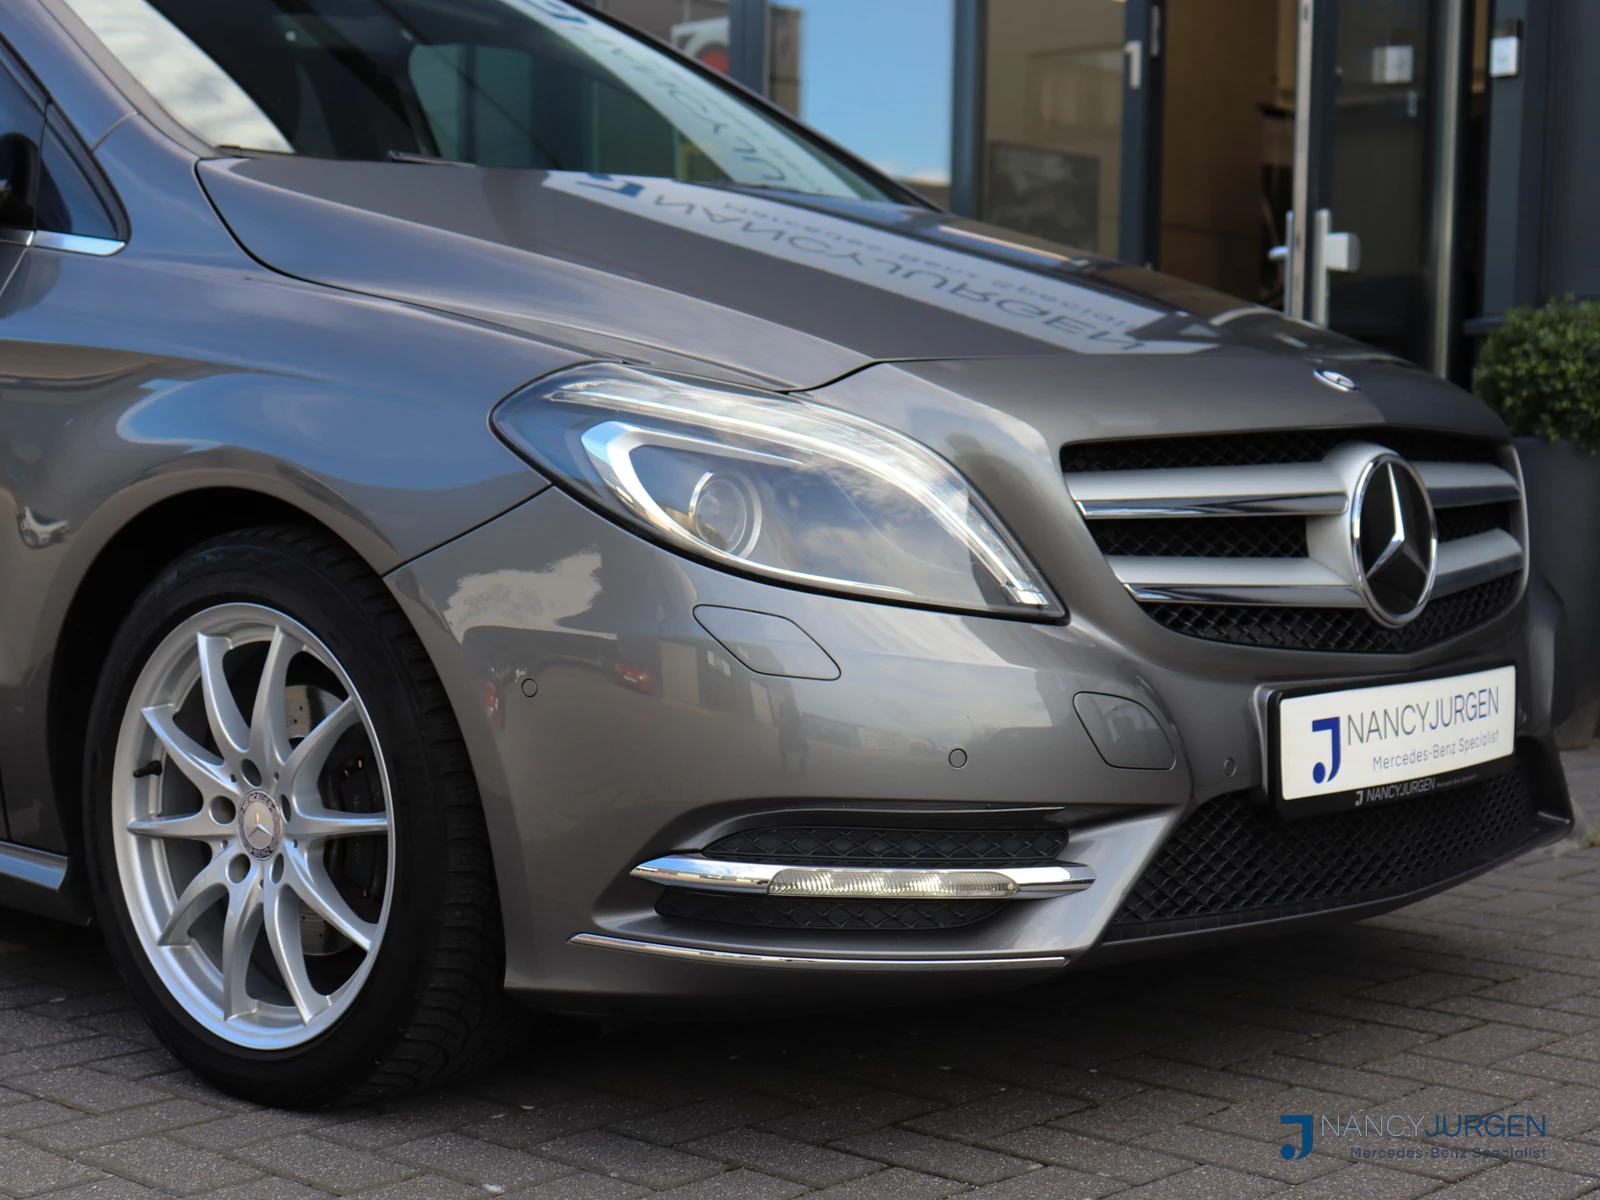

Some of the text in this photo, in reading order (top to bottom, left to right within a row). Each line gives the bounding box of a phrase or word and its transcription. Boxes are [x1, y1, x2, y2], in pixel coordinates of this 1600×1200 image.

[1347, 686, 1499, 746] NANCYJURGEN
[1372, 731, 1500, 771] Mercedes-Benz Specialist
[1366, 777, 1437, 803] NANCYJURGEN
